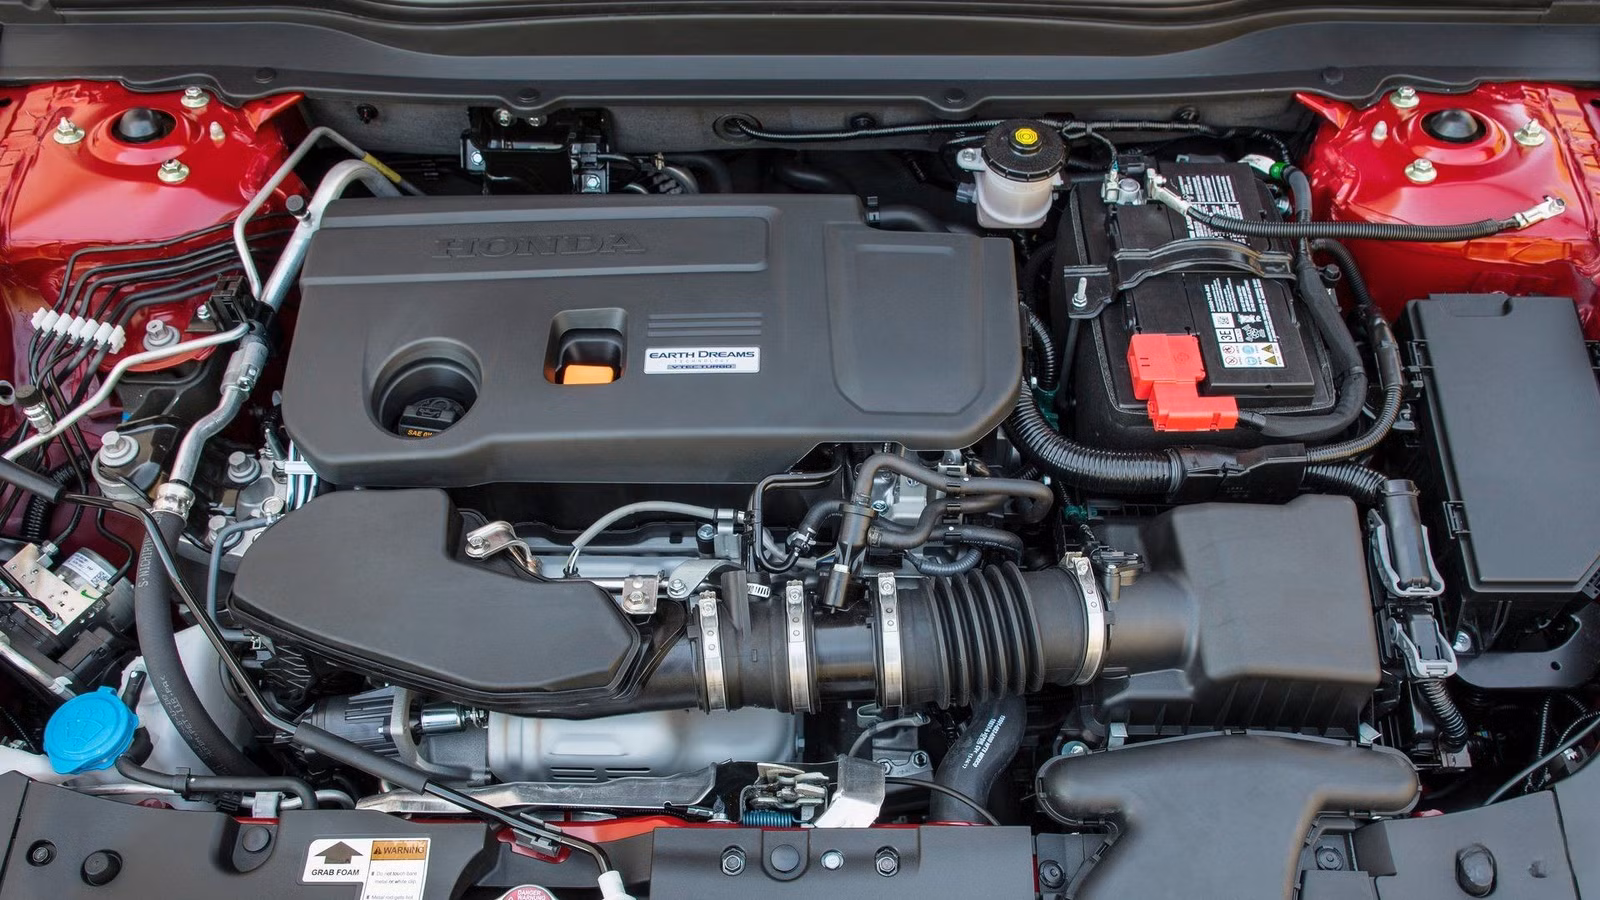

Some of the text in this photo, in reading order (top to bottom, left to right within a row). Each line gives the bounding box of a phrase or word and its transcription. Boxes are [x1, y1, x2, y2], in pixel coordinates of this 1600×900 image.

[432, 232, 646, 258] HONDA
[649, 350, 755, 359] EARTH DREAMS
[407, 429, 423, 437] SAE
[383, 846, 425, 854] WARNING
